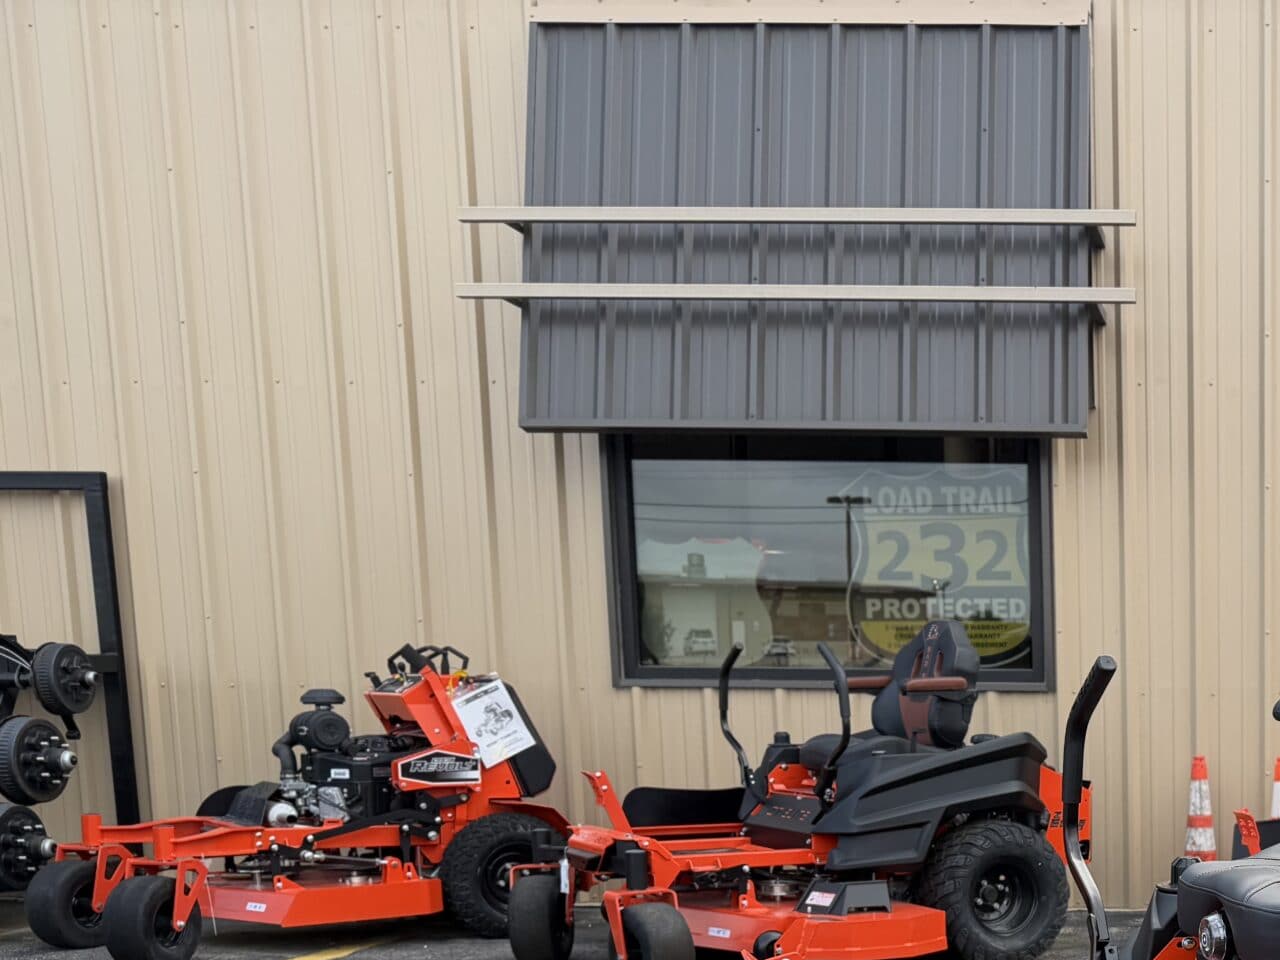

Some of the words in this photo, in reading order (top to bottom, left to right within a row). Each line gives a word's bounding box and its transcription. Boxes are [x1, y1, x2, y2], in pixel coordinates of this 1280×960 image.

[863, 485, 933, 513] LOAD
[941, 485, 1021, 513] TRAIL
[877, 521, 1012, 593] 232
[865, 597, 1026, 619] PROTECTED
